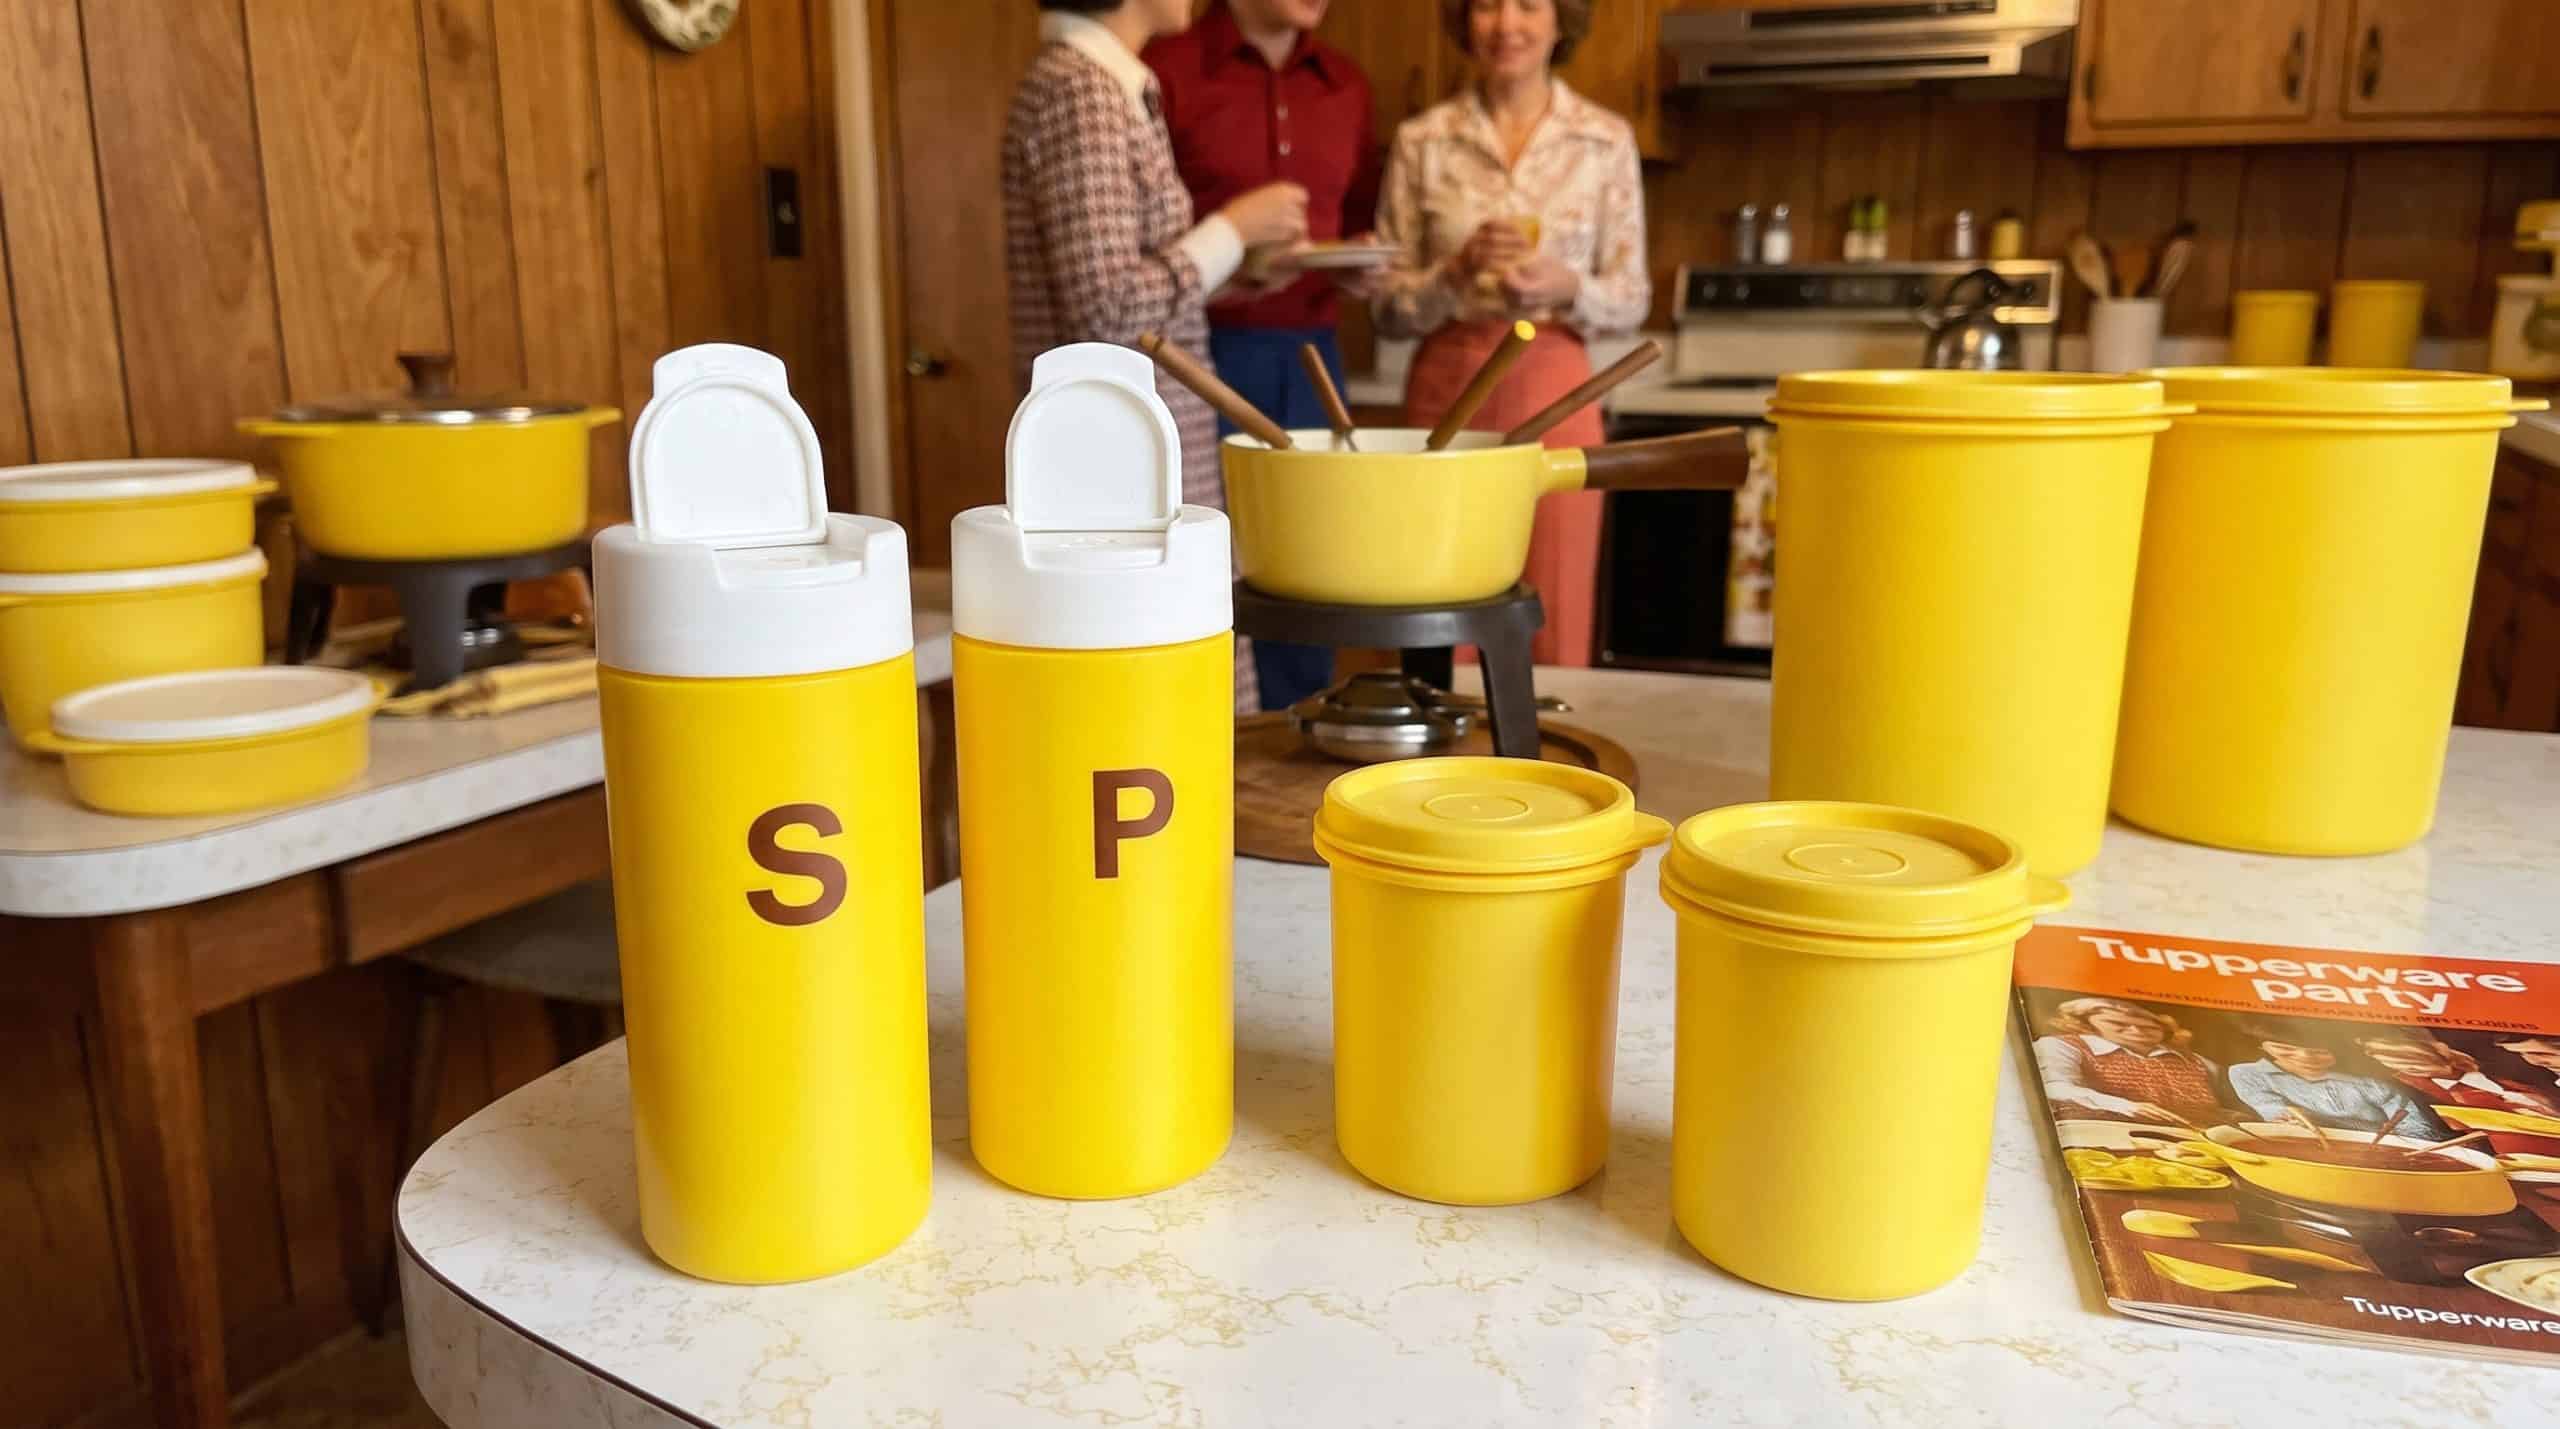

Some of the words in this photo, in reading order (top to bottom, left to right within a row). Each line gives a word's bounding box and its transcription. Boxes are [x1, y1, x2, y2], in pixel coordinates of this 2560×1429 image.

[1092, 768, 1174, 880] P
[745, 803, 848, 926] S
[2078, 936, 2527, 992] Tupperware
[2252, 978, 2448, 1014] party
[2342, 1296, 2560, 1335] Tupperware
